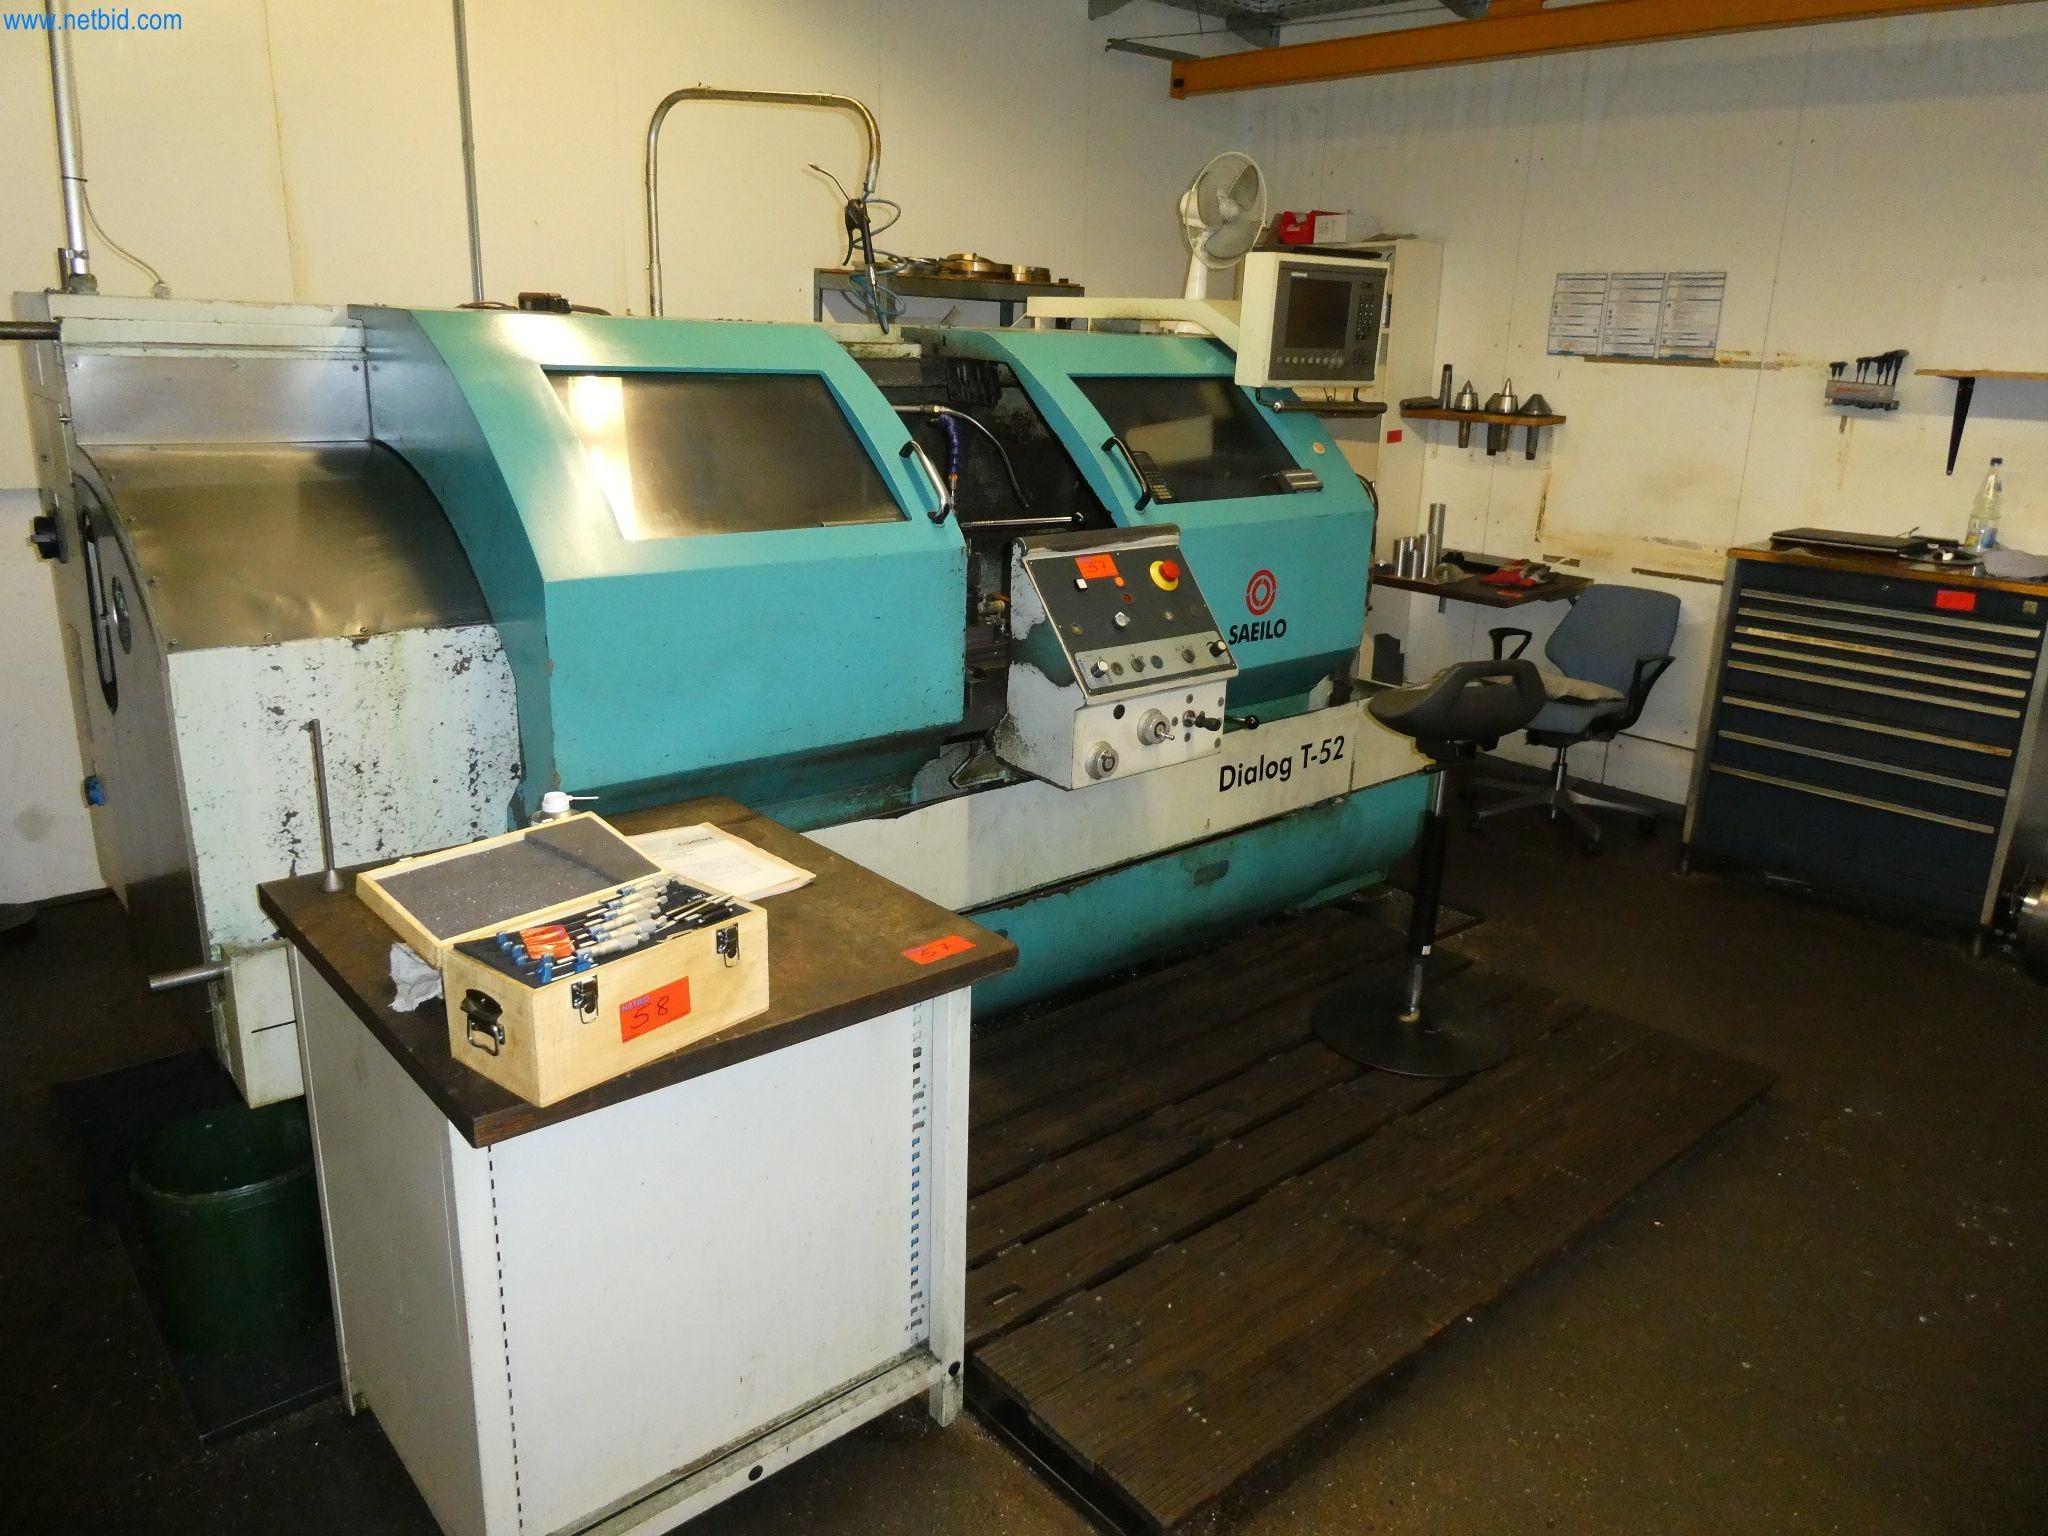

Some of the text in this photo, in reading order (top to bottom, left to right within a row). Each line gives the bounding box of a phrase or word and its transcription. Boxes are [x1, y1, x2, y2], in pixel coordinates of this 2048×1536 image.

[1087, 560, 1106, 573] 57
[1228, 618, 1287, 646] SAEILO
[1219, 735, 1345, 792] Dialog T-52
[630, 995, 670, 1029] 58
